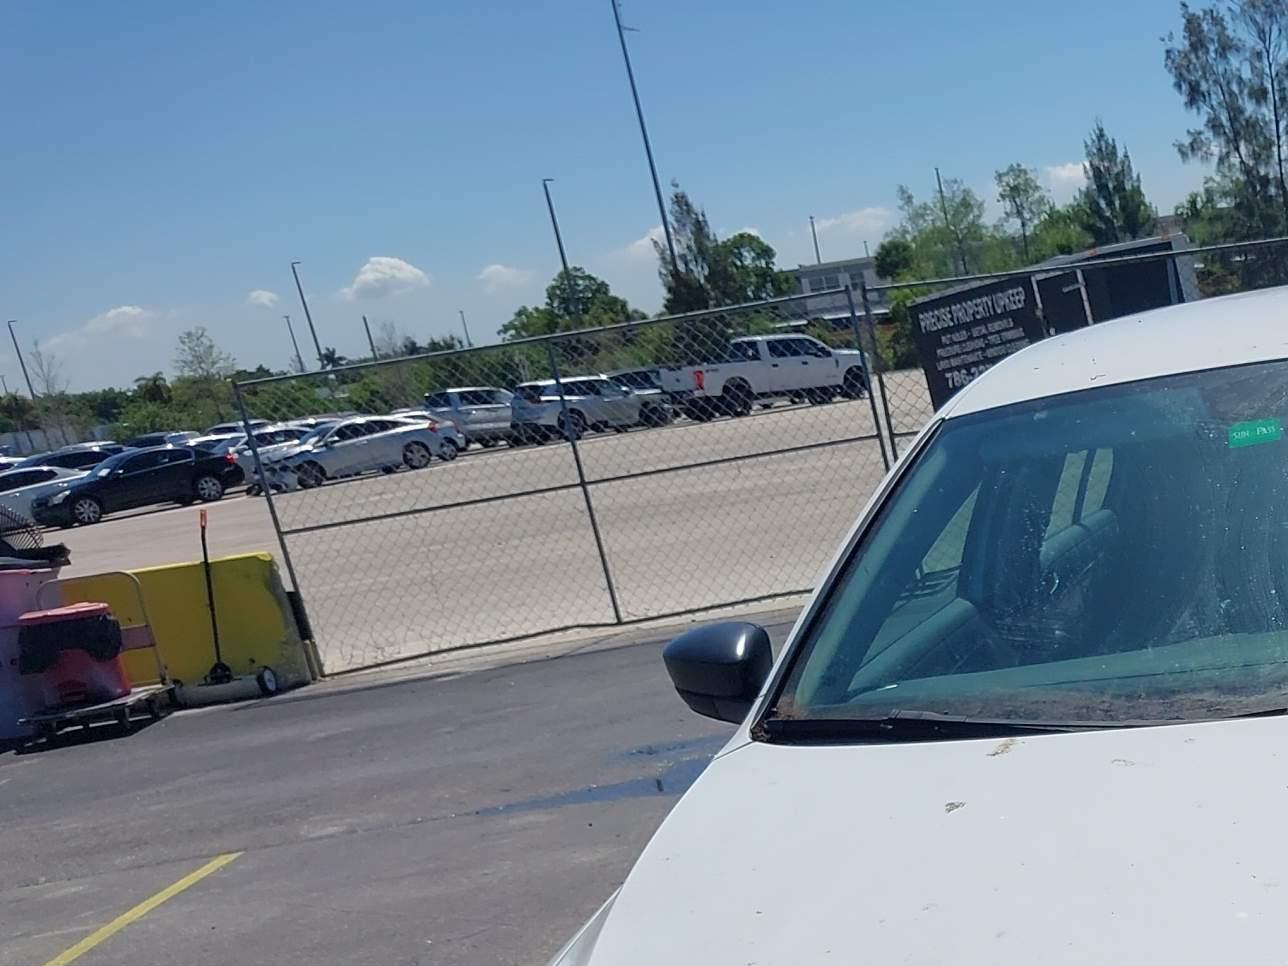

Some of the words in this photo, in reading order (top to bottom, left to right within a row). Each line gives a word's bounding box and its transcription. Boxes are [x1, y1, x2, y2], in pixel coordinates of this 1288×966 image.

[918, 307, 954, 333] PRECISE
[952, 296, 994, 324] PROPERTY
[993, 287, 1025, 314] UPKEEP
